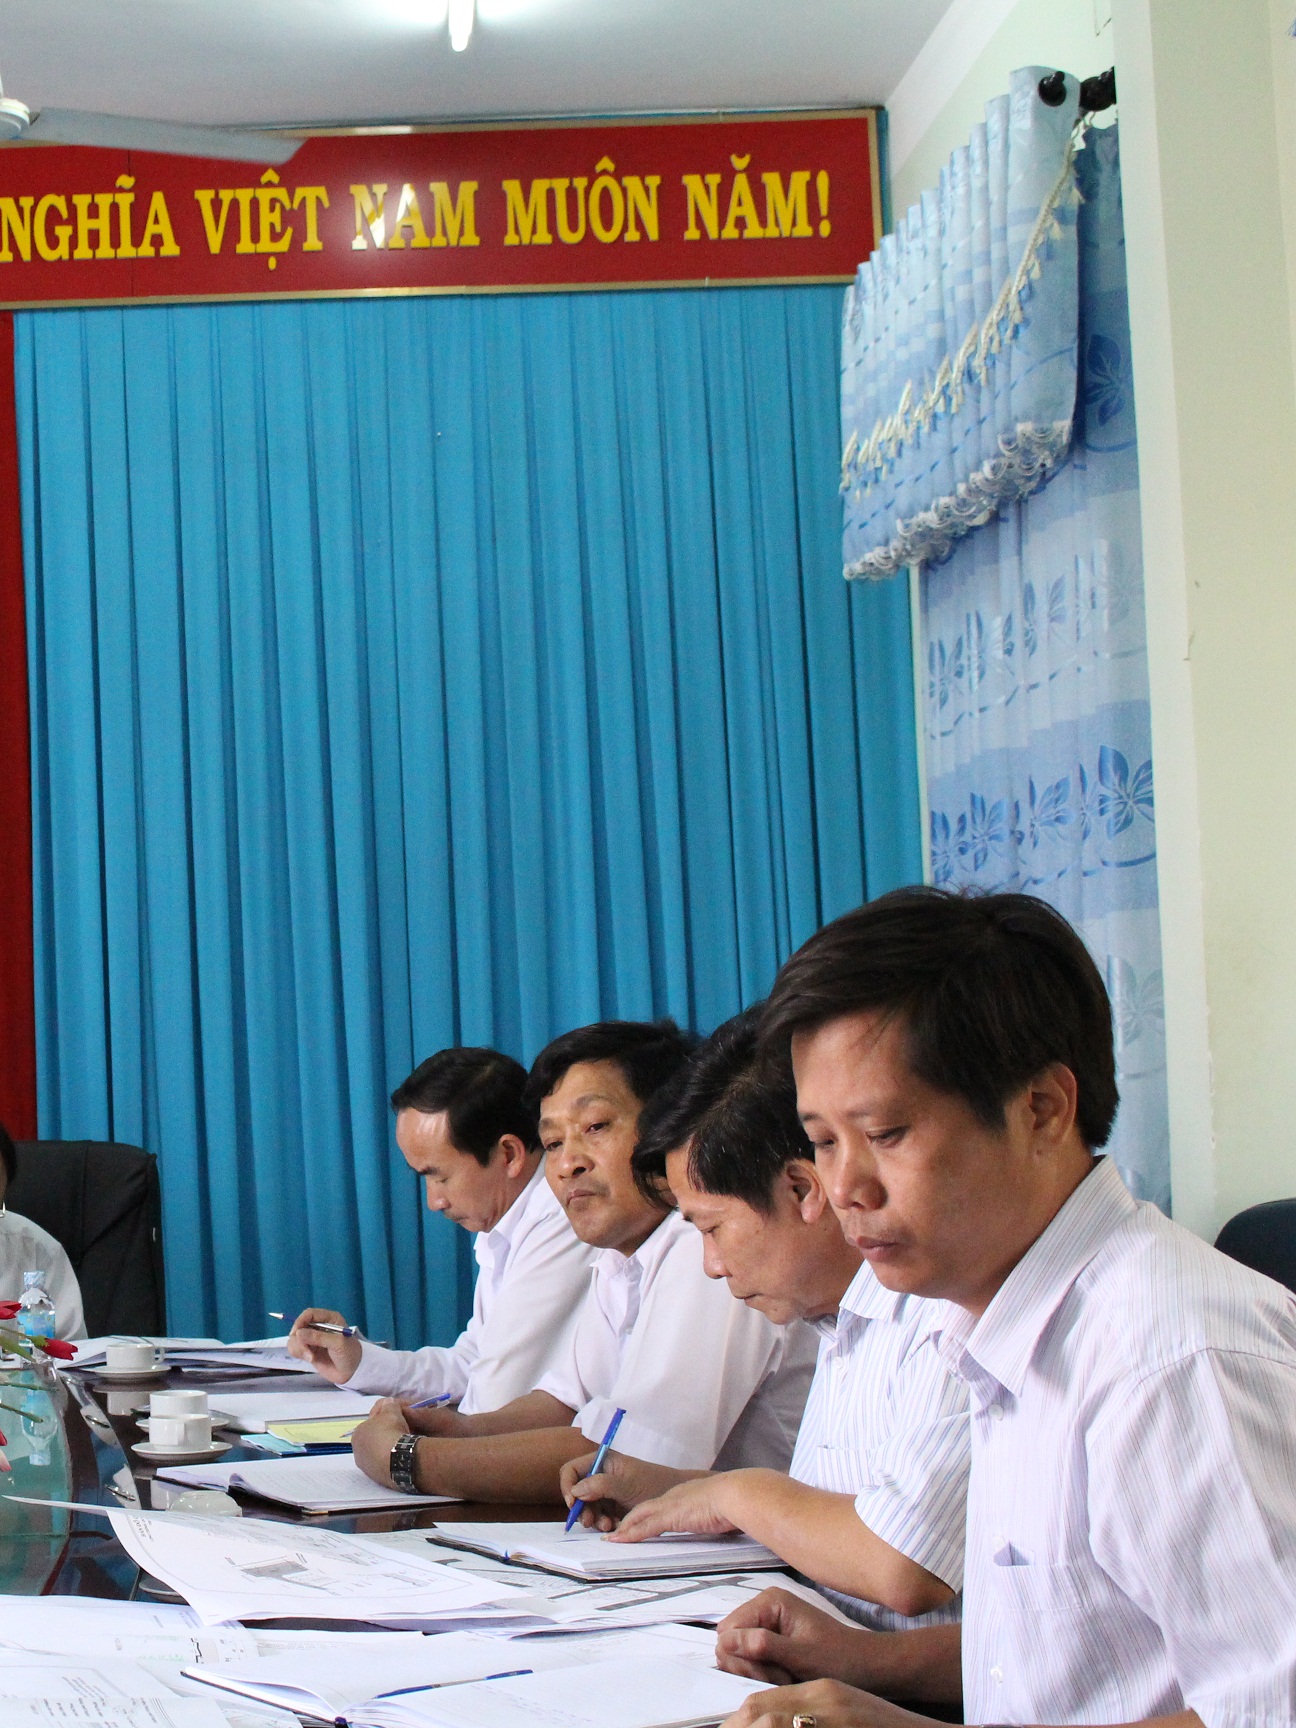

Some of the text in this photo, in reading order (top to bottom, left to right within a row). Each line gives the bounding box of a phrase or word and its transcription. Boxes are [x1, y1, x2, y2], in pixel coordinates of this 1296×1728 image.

[194, 168, 330, 270] VIỆT
[350, 181, 480, 250] NAM
[503, 157, 661, 246] MUÔN
[683, 154, 831, 240] NĂM!
